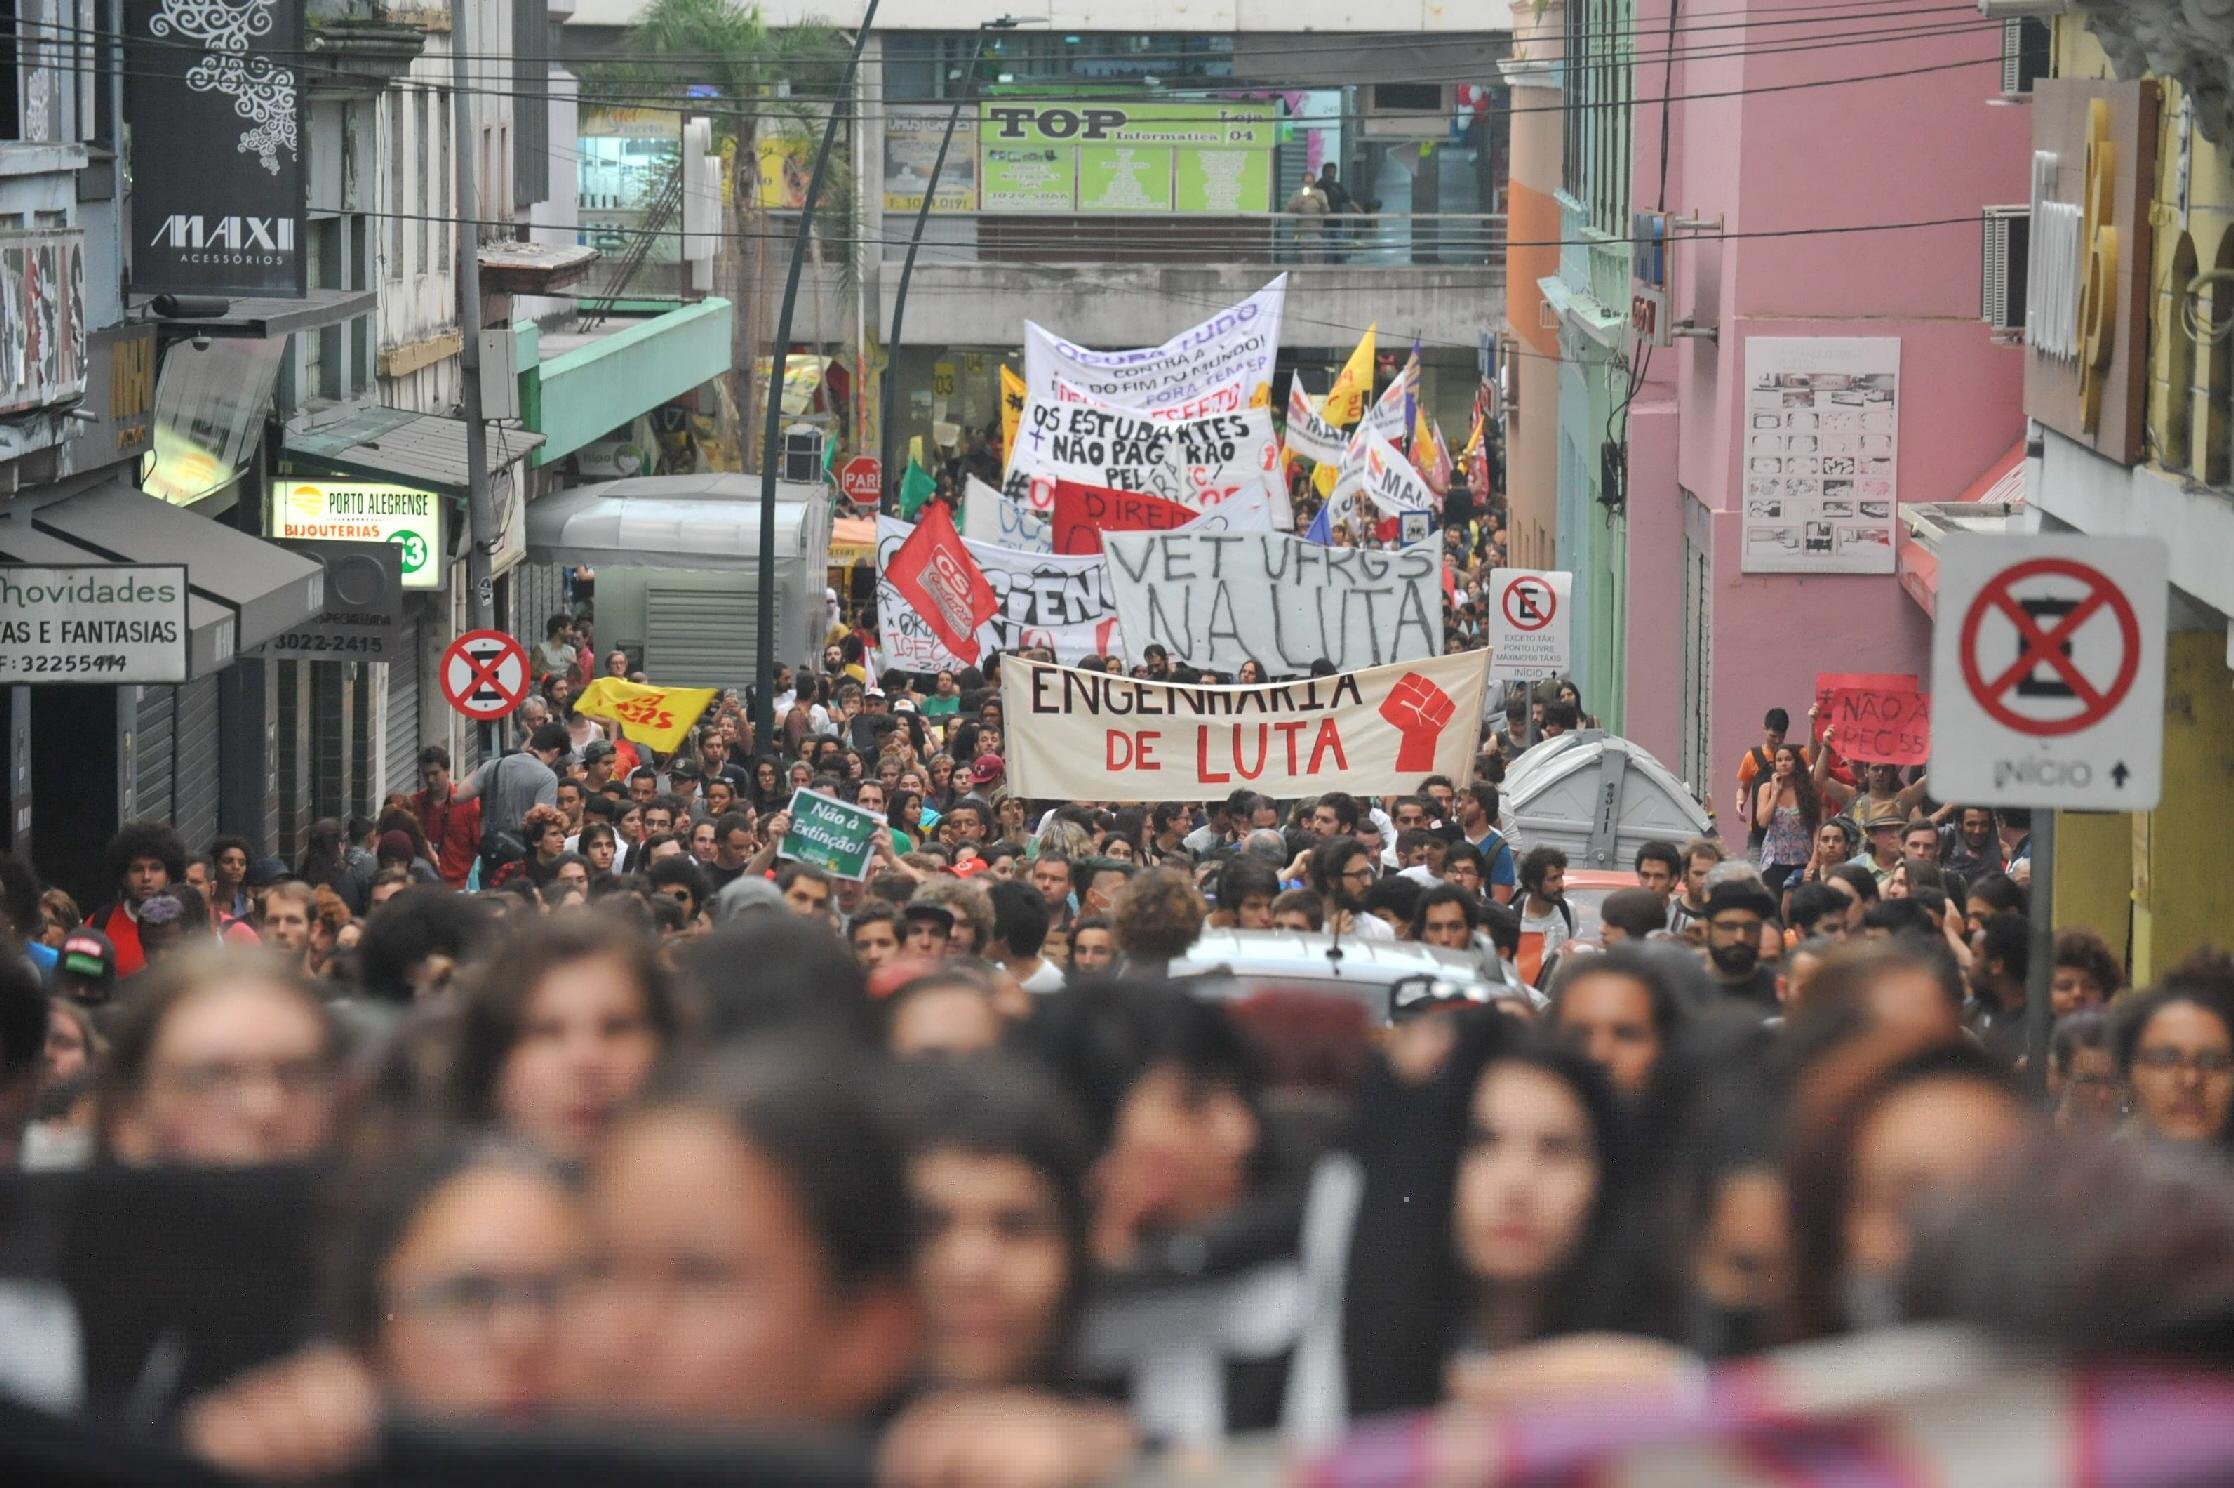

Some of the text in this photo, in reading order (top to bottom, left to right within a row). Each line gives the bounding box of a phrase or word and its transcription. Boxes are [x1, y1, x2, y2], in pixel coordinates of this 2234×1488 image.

[990, 108, 1127, 139] TOP
[150, 214, 294, 250] MAXI
[180, 254, 284, 265] ACESSÓRIOS
[1113, 353, 1190, 378] CONTRA
[1123, 378, 1158, 393] FIM
[1145, 383, 1198, 406] FORA
[1034, 404, 1250, 444] OS ESTUDANTES
[1053, 434, 1104, 466] NÃO
[329, 492, 428, 517] PORTO ALEGRENSE
[285, 524, 381, 538] BIJOUTERIAS
[1110, 535, 1244, 583] VET
[1261, 536, 1436, 587] UFRGS
[0, 620, 178, 644] AS E FANTASIAS
[1147, 579, 1258, 662] NA
[1270, 579, 1436, 669] LUTA
[274, 633, 382, 653] 3022-2415
[1513, 666, 1543, 678] INÍCIO
[1032, 667, 1363, 715] ENGENHARIA
[1842, 692, 1902, 722] NÃO
[1106, 717, 1349, 783] DE LUTA
[1841, 726, 1925, 757] PEC 55
[1994, 754, 2093, 789] INÍCIO
[811, 801, 861, 831] Não à
[792, 818, 865, 856] Extinção!
